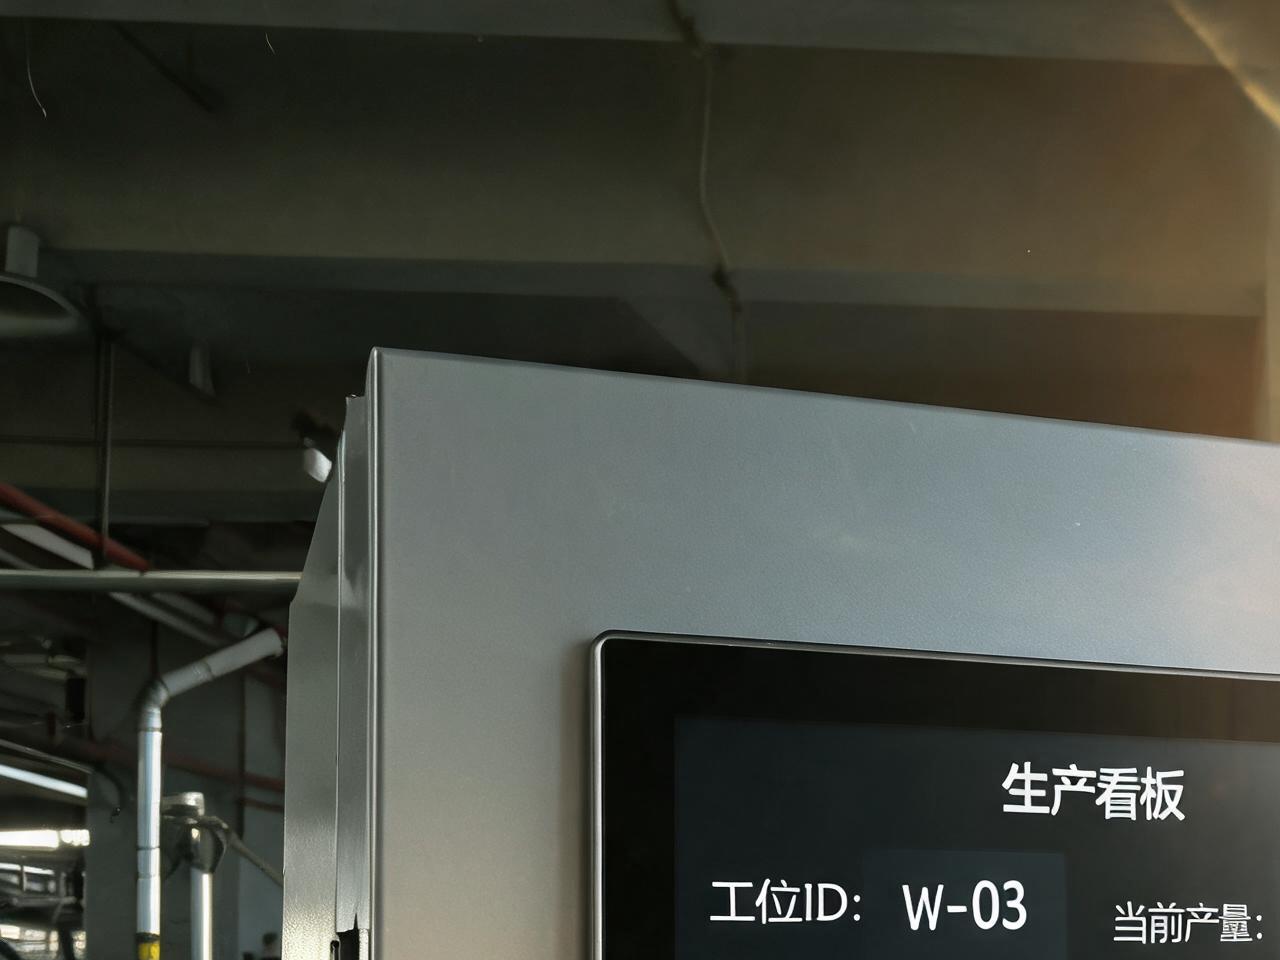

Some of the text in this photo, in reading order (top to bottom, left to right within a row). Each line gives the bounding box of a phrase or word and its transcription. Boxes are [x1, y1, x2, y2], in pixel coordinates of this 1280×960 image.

[1001, 761, 1186, 822] 生产看板
[709, 878, 1027, 931] 工位ID: W-03
